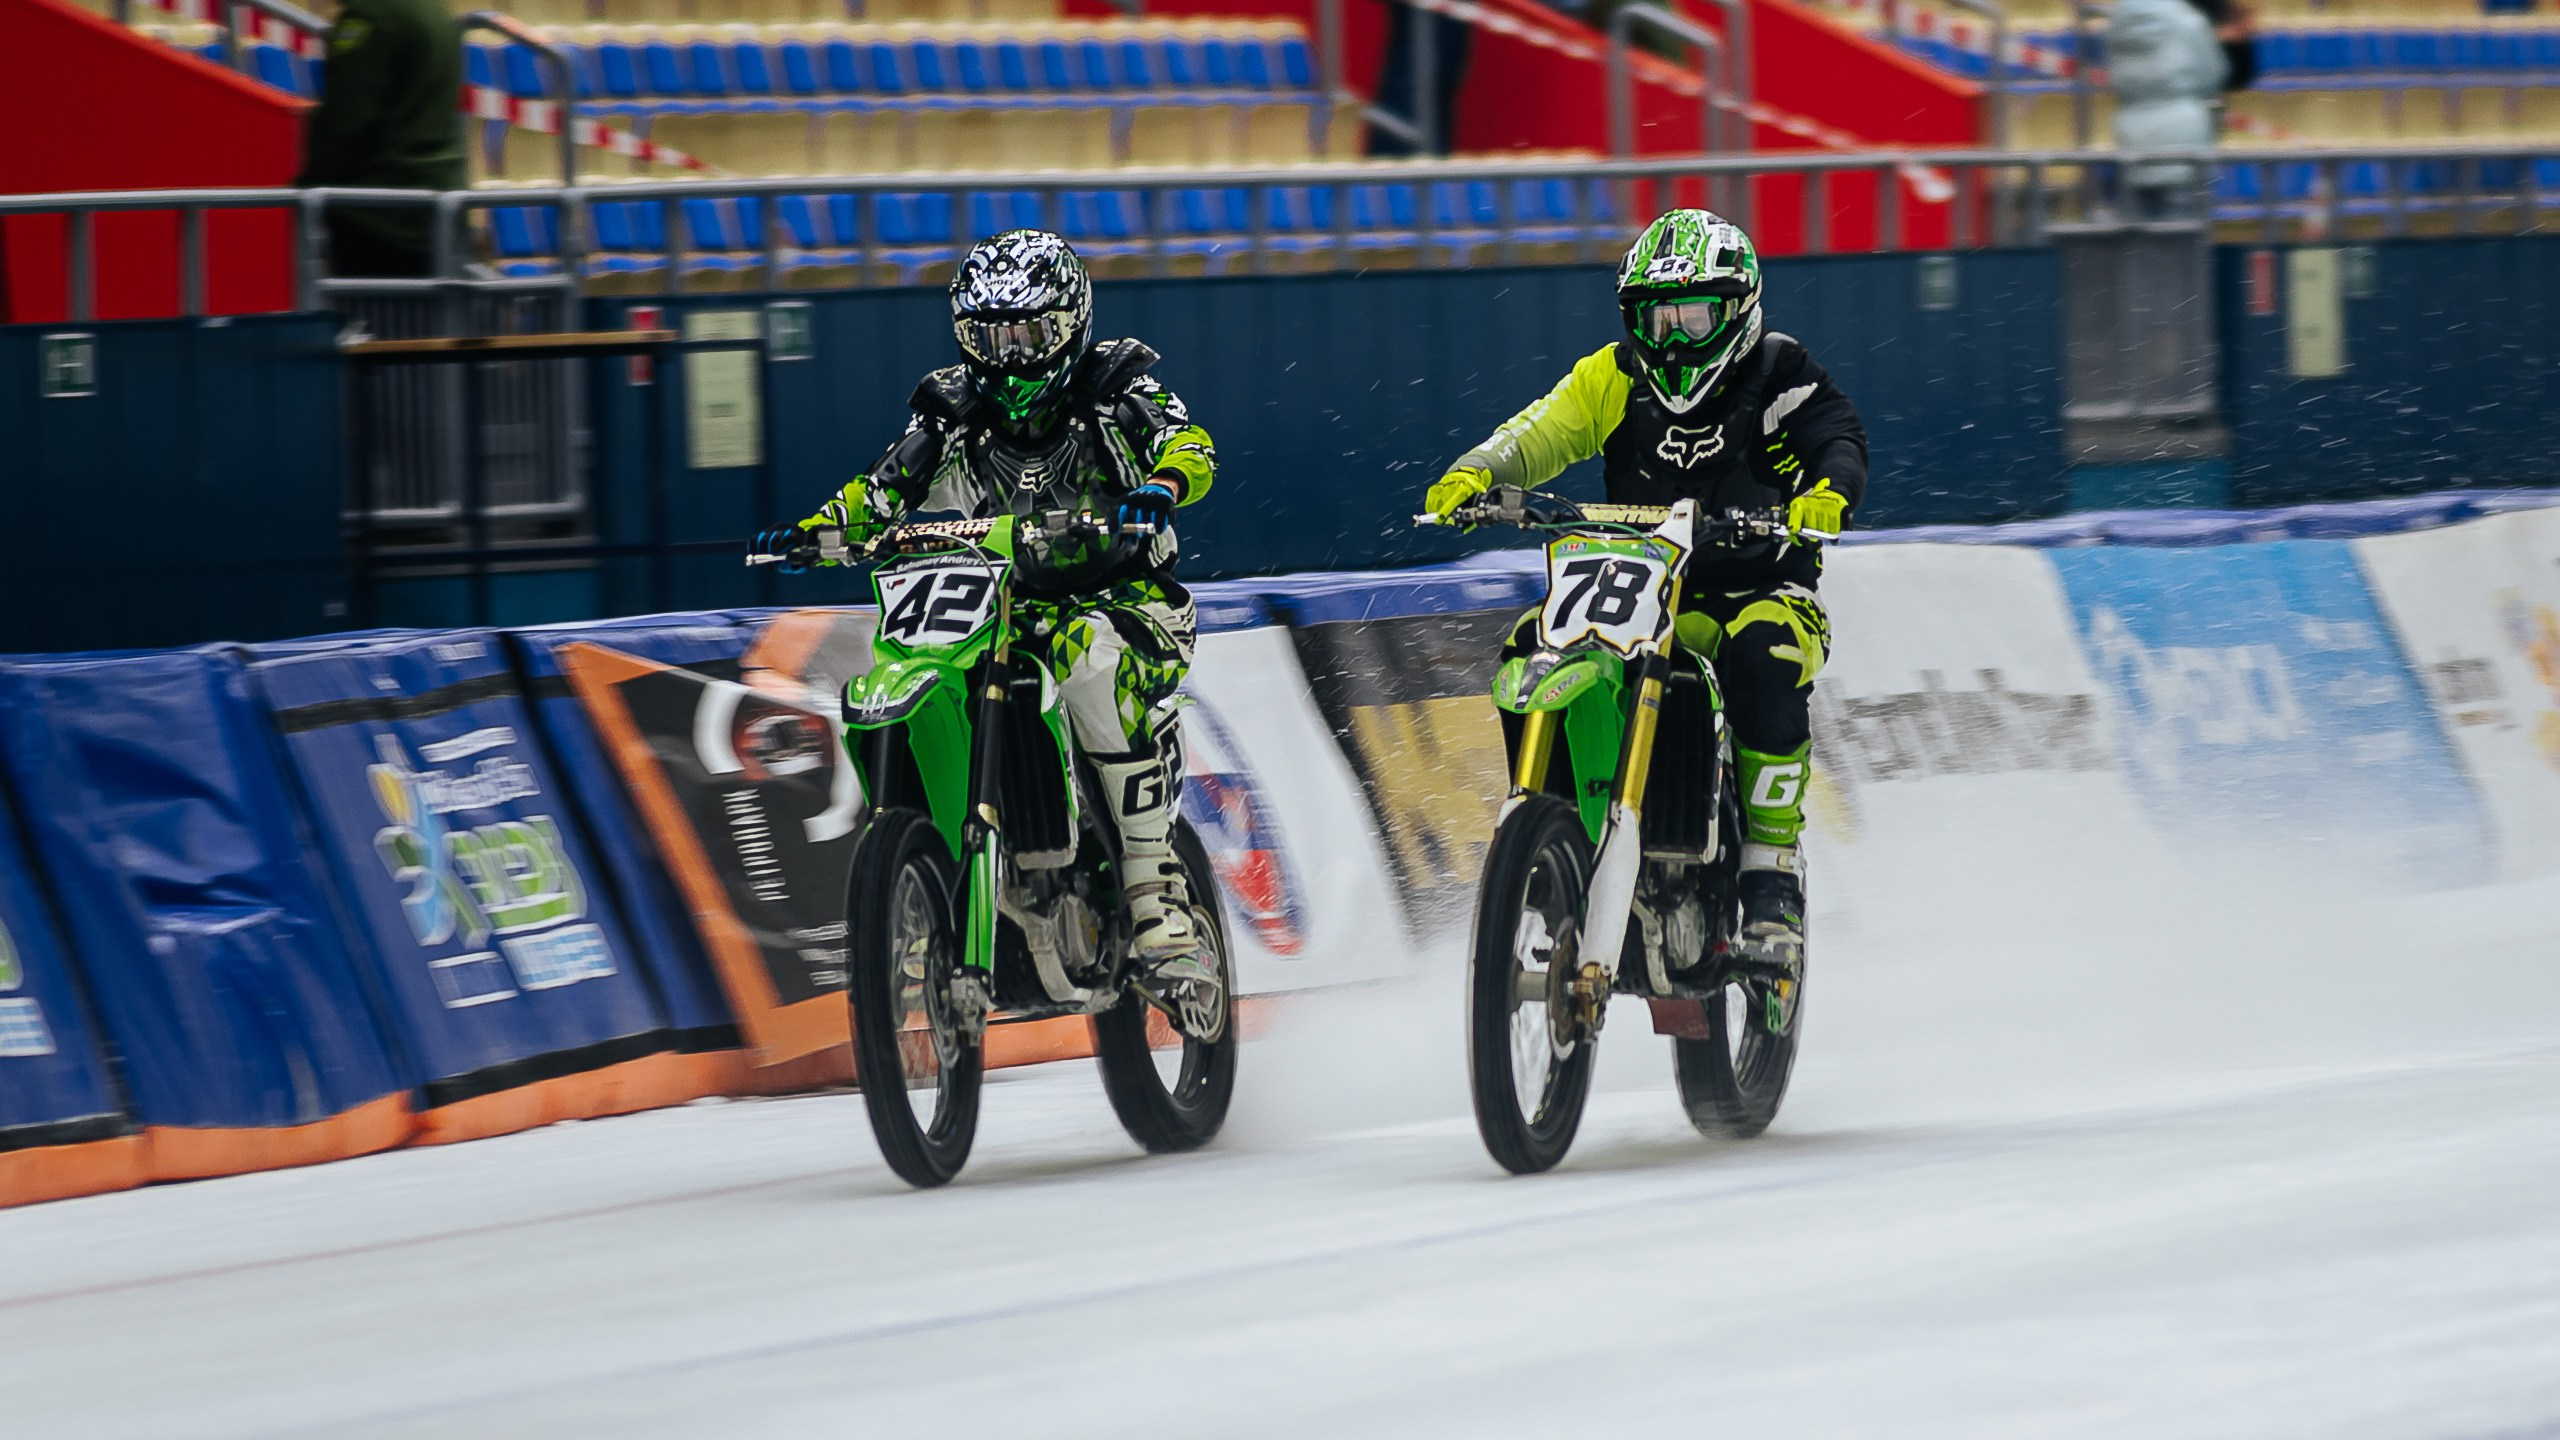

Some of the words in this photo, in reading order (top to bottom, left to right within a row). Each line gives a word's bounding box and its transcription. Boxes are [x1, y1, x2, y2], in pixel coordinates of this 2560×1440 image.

[884, 572, 991, 639] 42
[1550, 557, 1652, 632] 78
[1122, 763, 1163, 817] G
[1750, 762, 1803, 807] G
